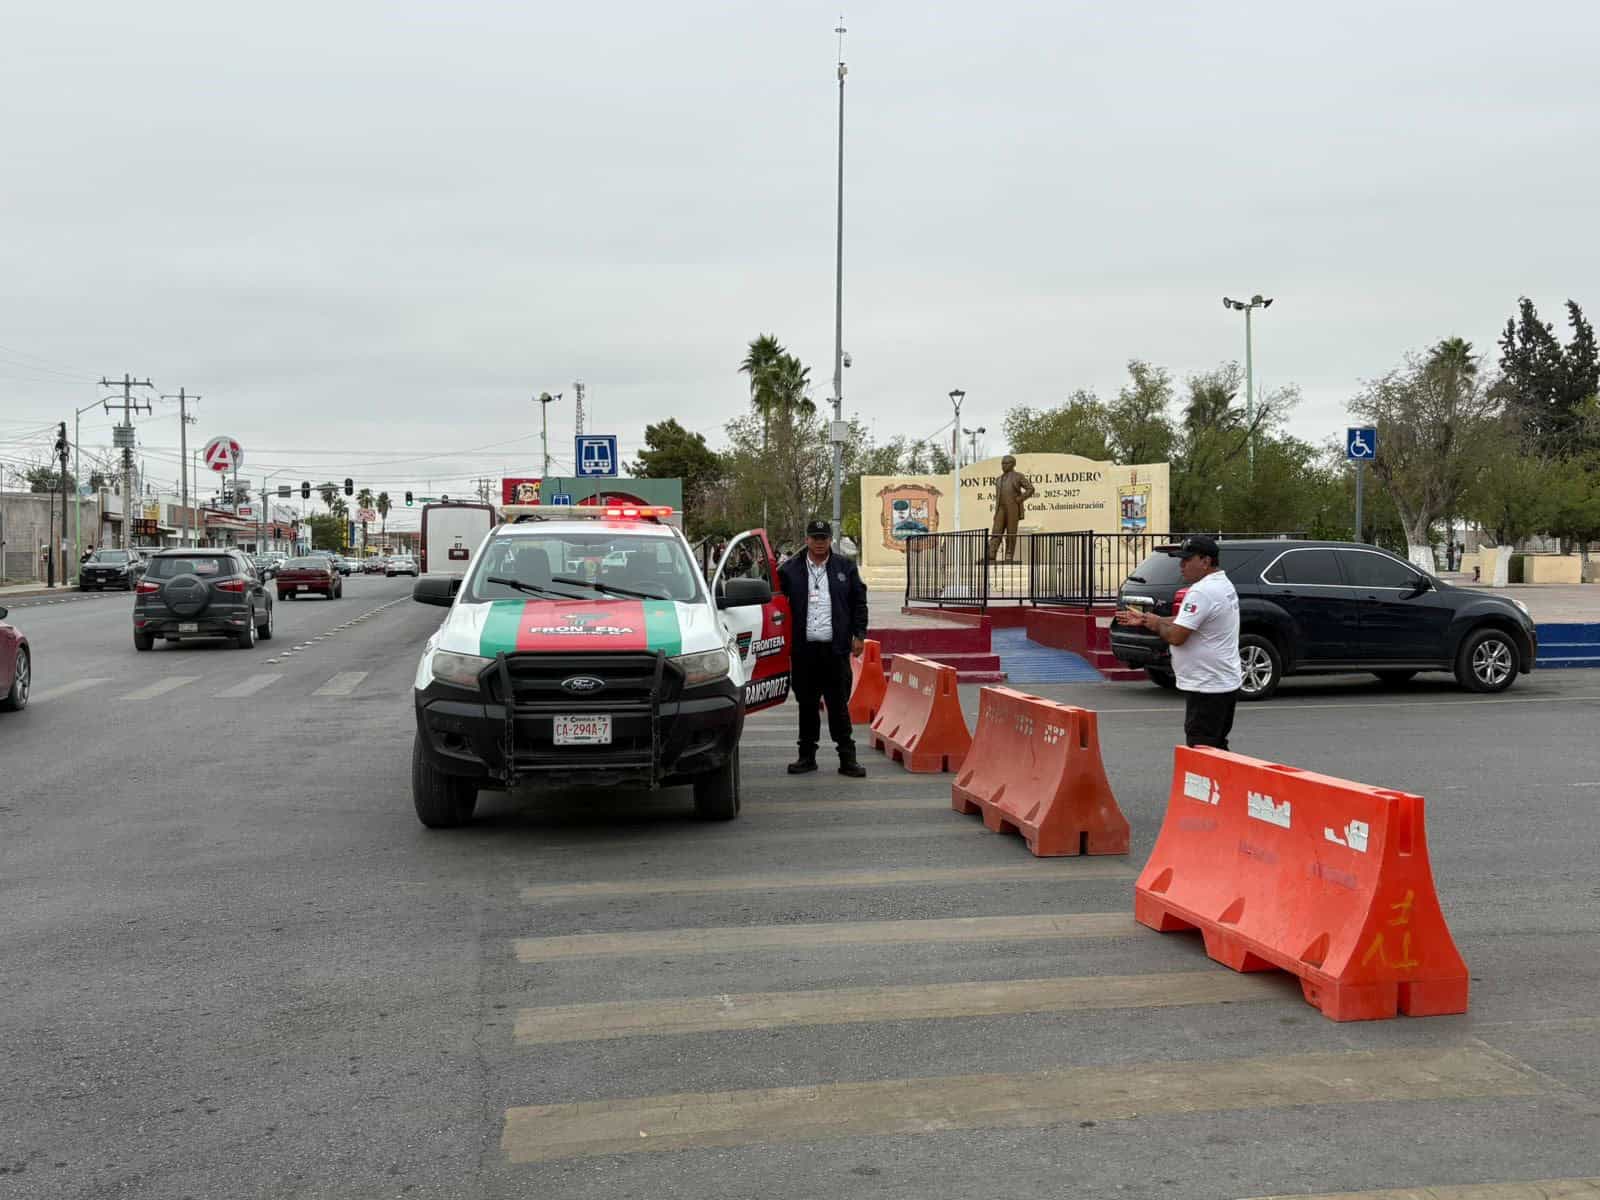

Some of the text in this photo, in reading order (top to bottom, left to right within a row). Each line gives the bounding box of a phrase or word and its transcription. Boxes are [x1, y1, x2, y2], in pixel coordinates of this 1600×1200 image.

[1055, 471, 1102, 483] MADERO
[1044, 488, 1081, 498] 2025-2027
[529, 625, 634, 633] FRONERA
[752, 635, 785, 653] FRONTERA
[745, 676, 789, 705] RANSPORTE
